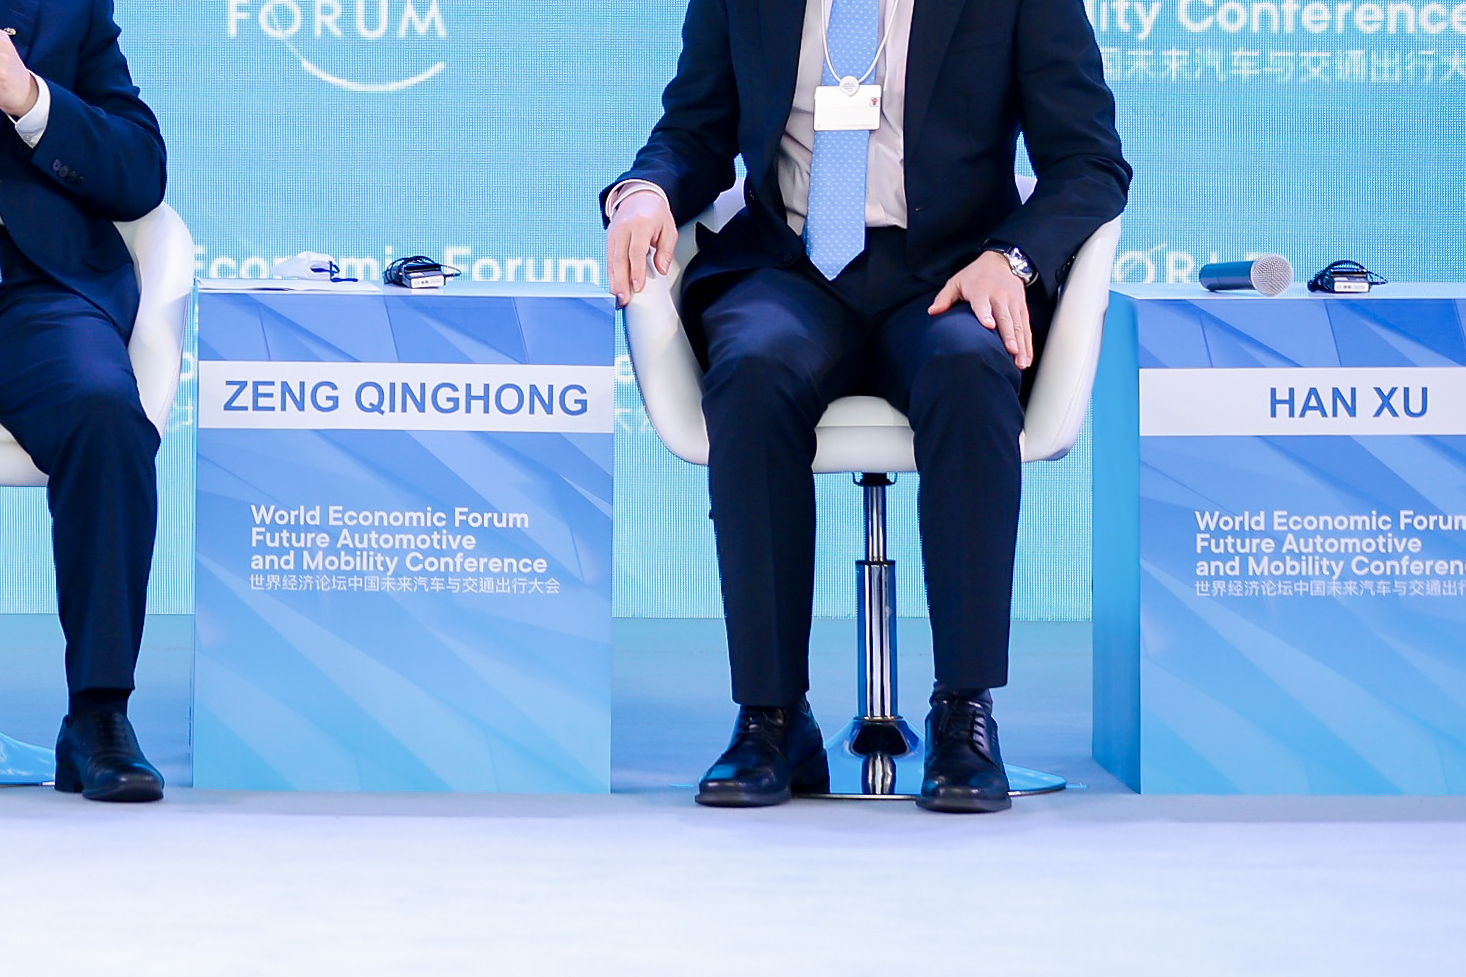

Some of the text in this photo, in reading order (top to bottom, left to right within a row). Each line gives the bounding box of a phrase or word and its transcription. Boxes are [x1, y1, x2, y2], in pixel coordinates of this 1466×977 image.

[445, 244, 602, 282] Forum
[223, 380, 588, 417] ZENG QINGHONG
[1270, 386, 1428, 418] HAN XU
[251, 504, 530, 529] World Economic Forum
[1195, 510, 1266, 531] World
[1273, 510, 1391, 531] Economic
[251, 526, 476, 550] Future Automotive
[1196, 532, 1422, 554] Future Automotive
[250, 550, 548, 577] and Mobility Conference
[1195, 554, 1466, 582] and Mobility Conferen
[250, 573, 560, 594] 世界经济论坛中国未来汽车与交通出行大会
[1195, 580, 1466, 598] 世界经济论坛中国未来汽车与交通出
